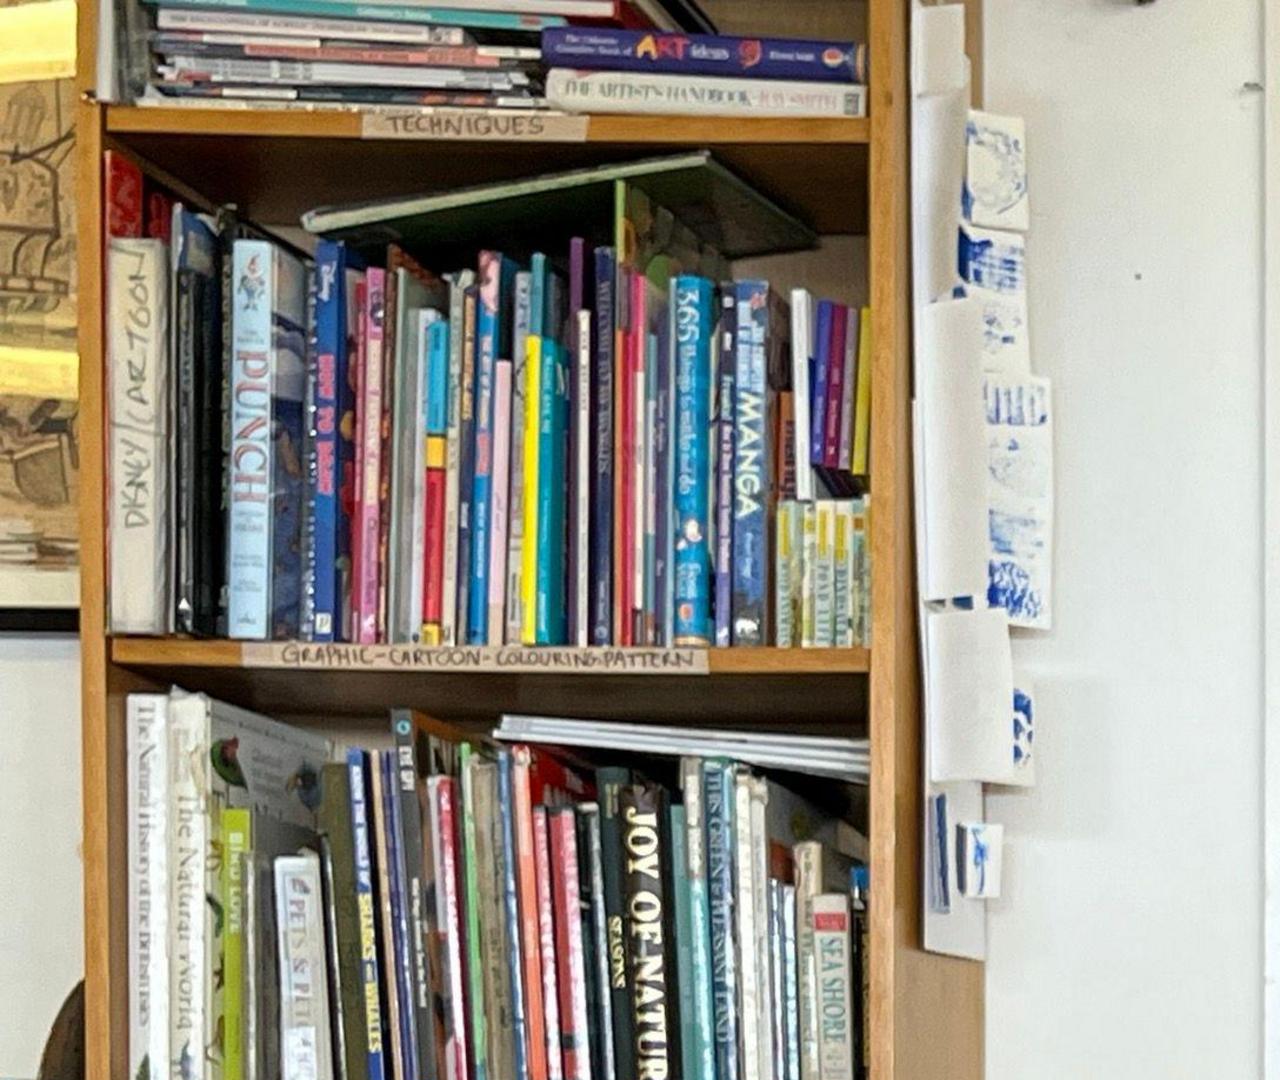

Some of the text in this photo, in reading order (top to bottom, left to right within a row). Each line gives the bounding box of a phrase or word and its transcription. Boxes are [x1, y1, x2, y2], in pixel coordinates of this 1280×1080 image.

[636, 34, 691, 62] ART
[385, 115, 545, 137] TECHNIQUES
[676, 289, 700, 343] 365
[233, 351, 269, 502] PUNCH
[735, 391, 763, 519] MANGA
[177, 793, 199, 840] The
[622, 806, 660, 880] JOY
[228, 831, 244, 935] BIRD LOVE
[359, 893, 376, 961] SHARKS
[608, 915, 627, 990] SEASONS
[631, 897, 662, 946] OF
[364, 981, 382, 1052] WHALES
[714, 989, 729, 1043] LAND
[819, 935, 847, 1044] SEA SHORE
